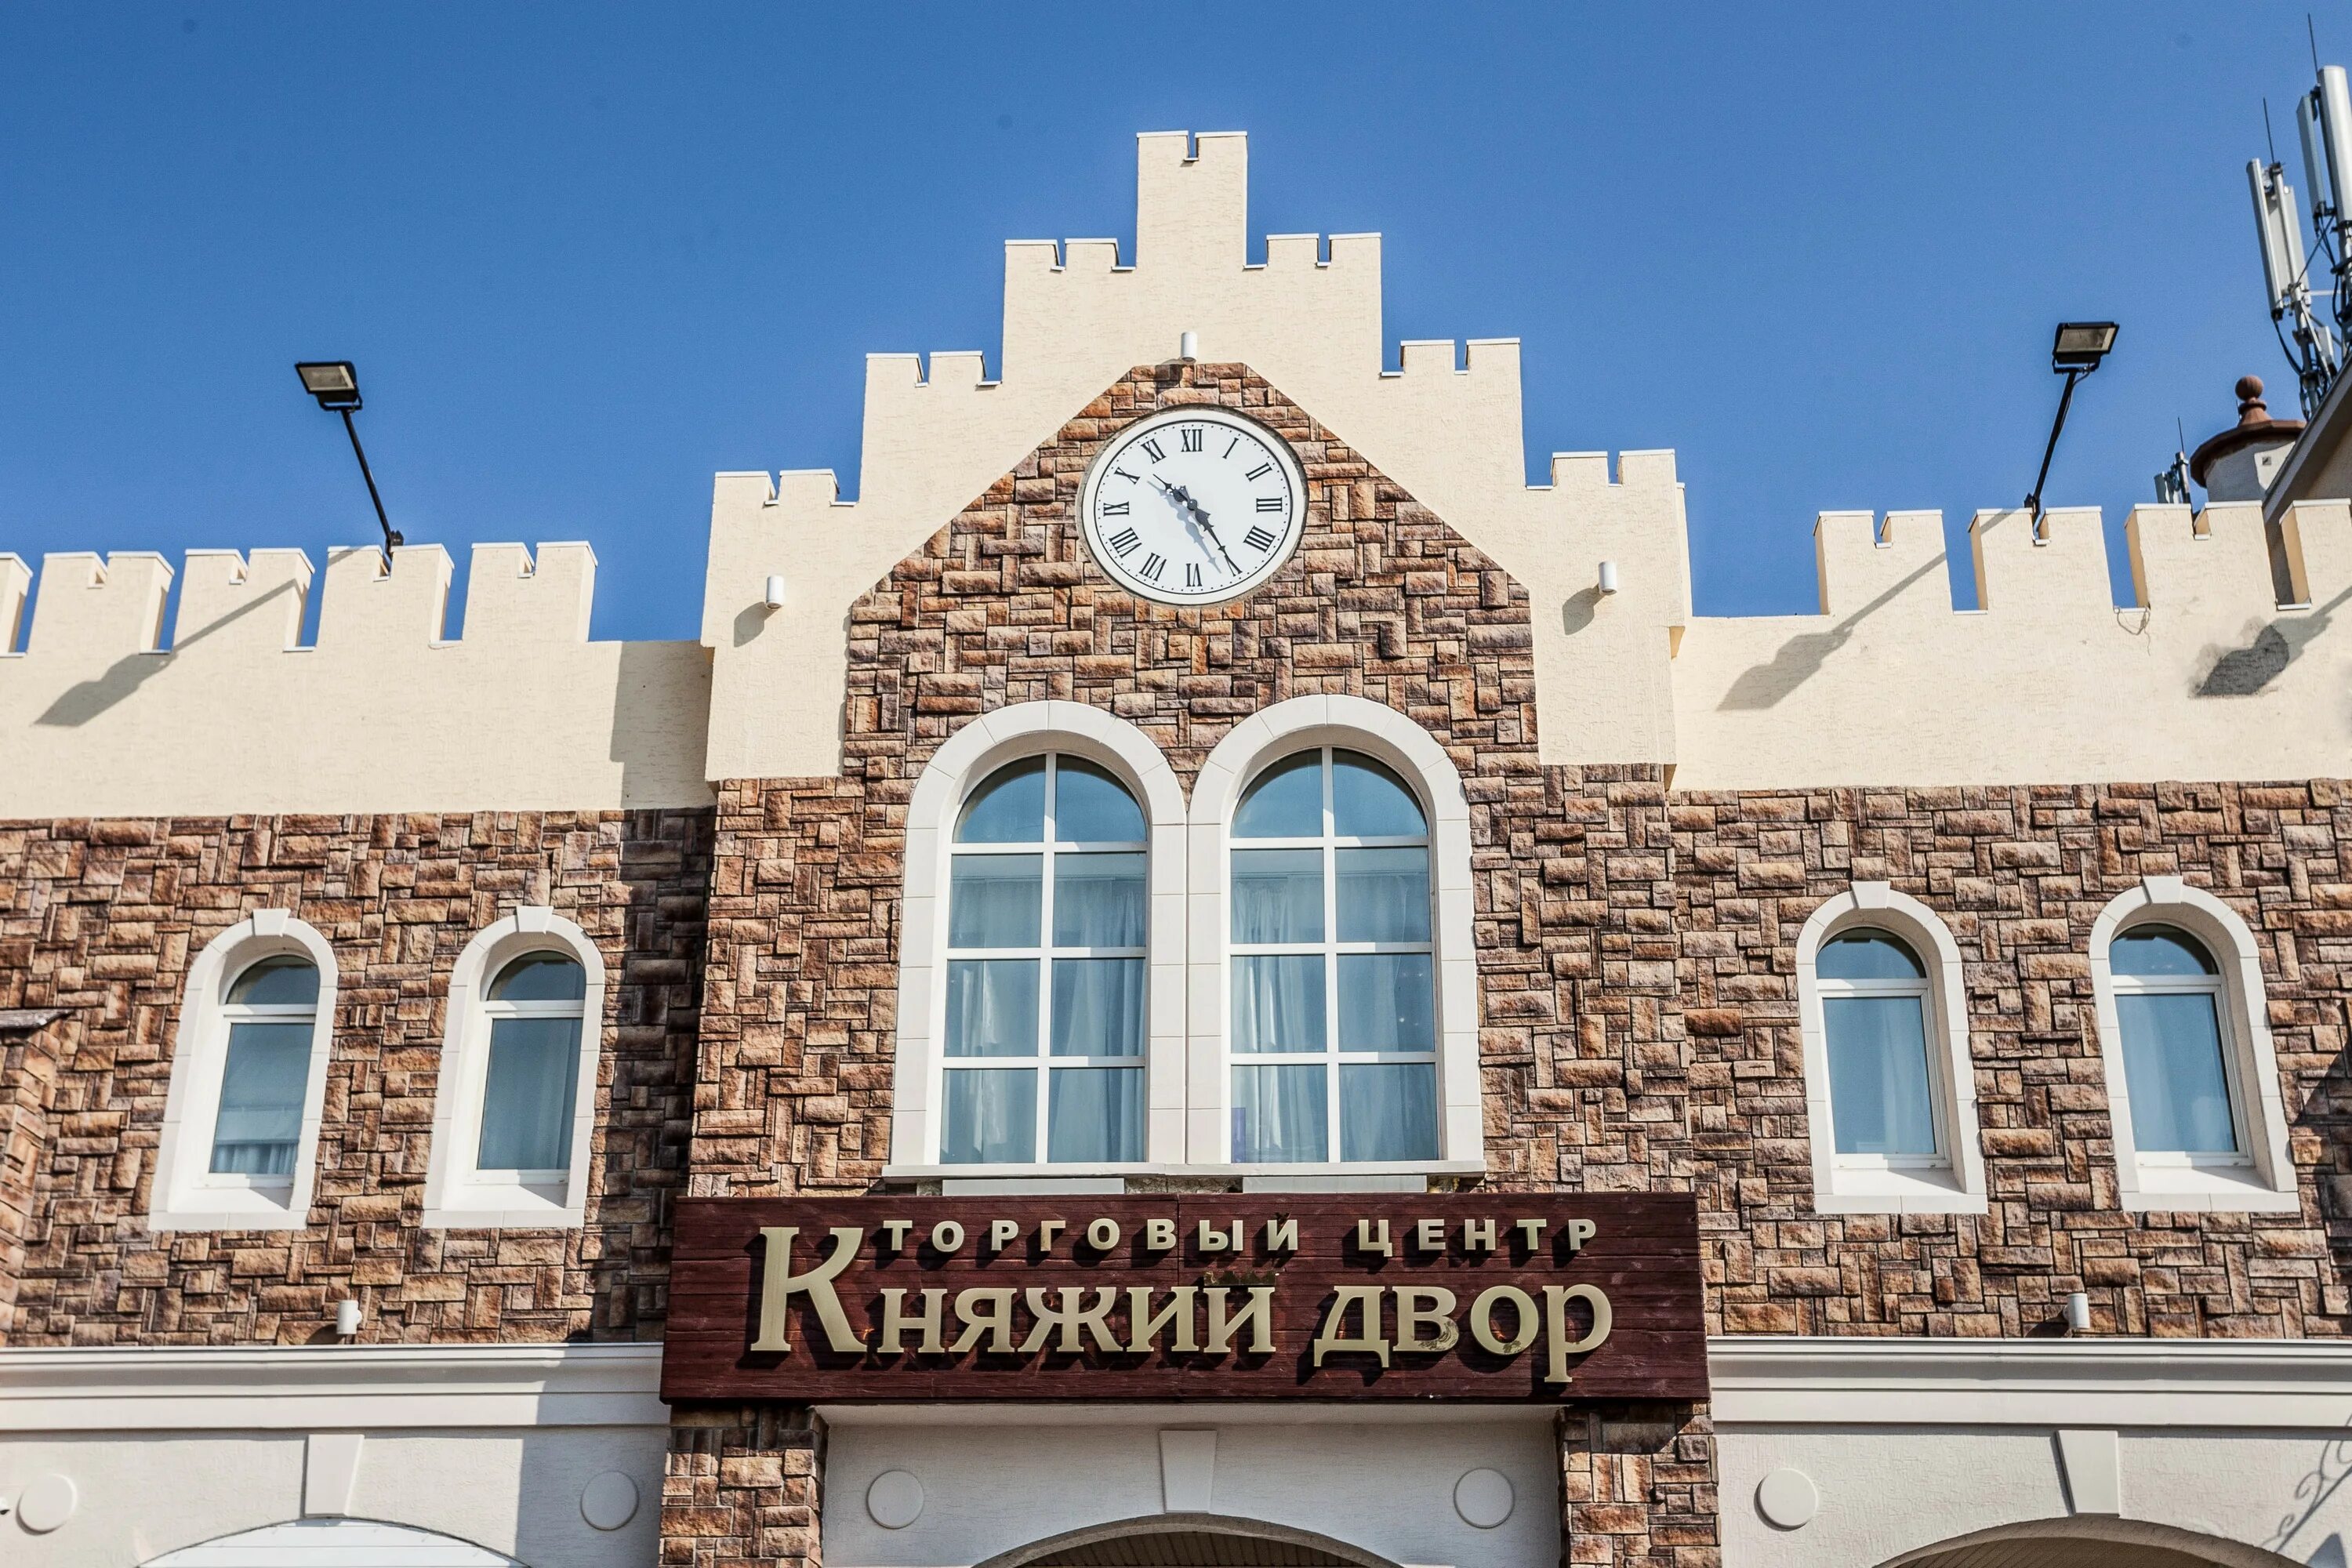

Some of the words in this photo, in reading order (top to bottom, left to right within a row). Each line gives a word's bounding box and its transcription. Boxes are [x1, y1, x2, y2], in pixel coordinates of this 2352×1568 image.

[1141, 438, 1166, 464] XI
[1181, 429, 1203, 452] XII
[1114, 467, 1140, 485] X
[1246, 463, 1272, 481] II
[1104, 502, 1129, 516] IX
[1256, 497, 1283, 513] III
[1109, 527, 1142, 558] VIII
[1243, 525, 1276, 553] IIII
[1139, 553, 1167, 582] VII
[1186, 564, 1202, 586] VI
[1358, 1218, 1596, 1257] ЦЕНТР
